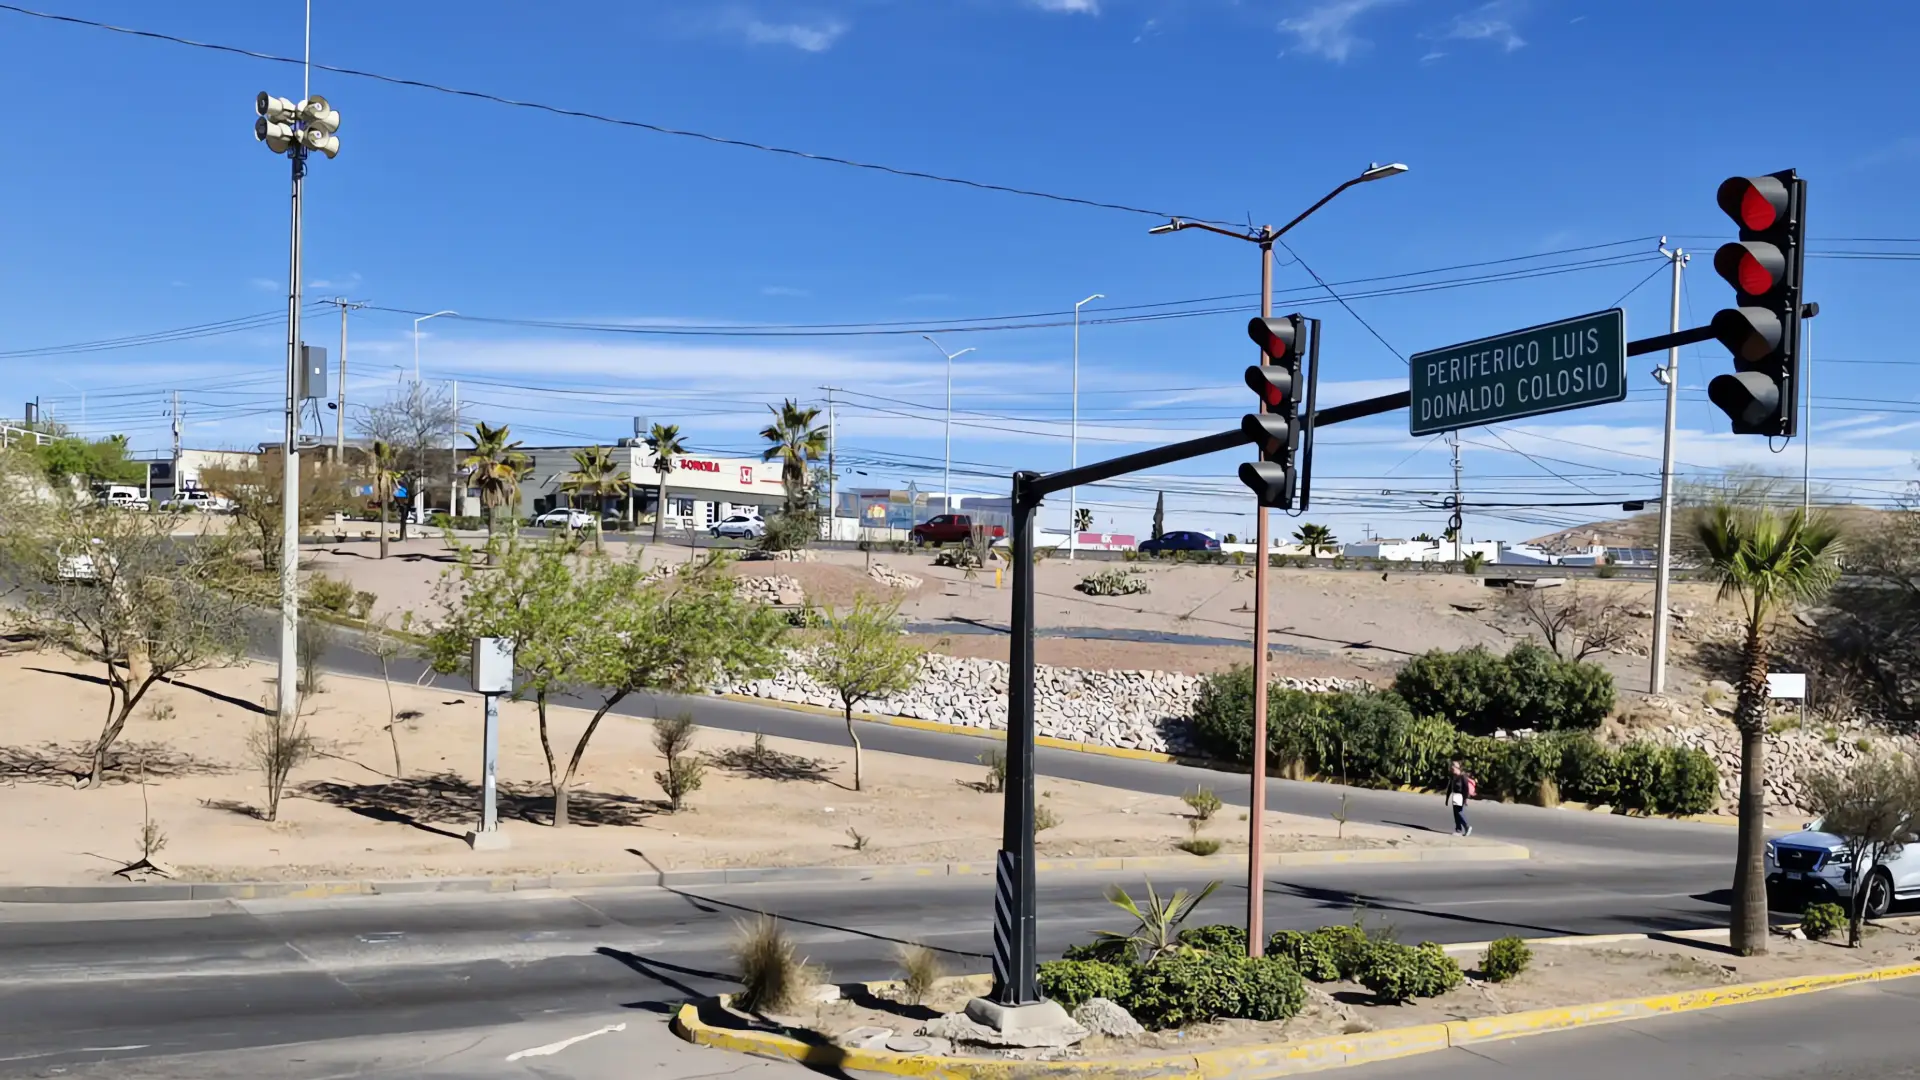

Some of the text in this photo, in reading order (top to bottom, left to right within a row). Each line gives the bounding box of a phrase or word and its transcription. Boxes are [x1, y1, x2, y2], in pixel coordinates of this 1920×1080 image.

[1427, 327, 1599, 387] PERIFERICO LUIS
[1421, 362, 1608, 421] DONALDO COLOSIO
